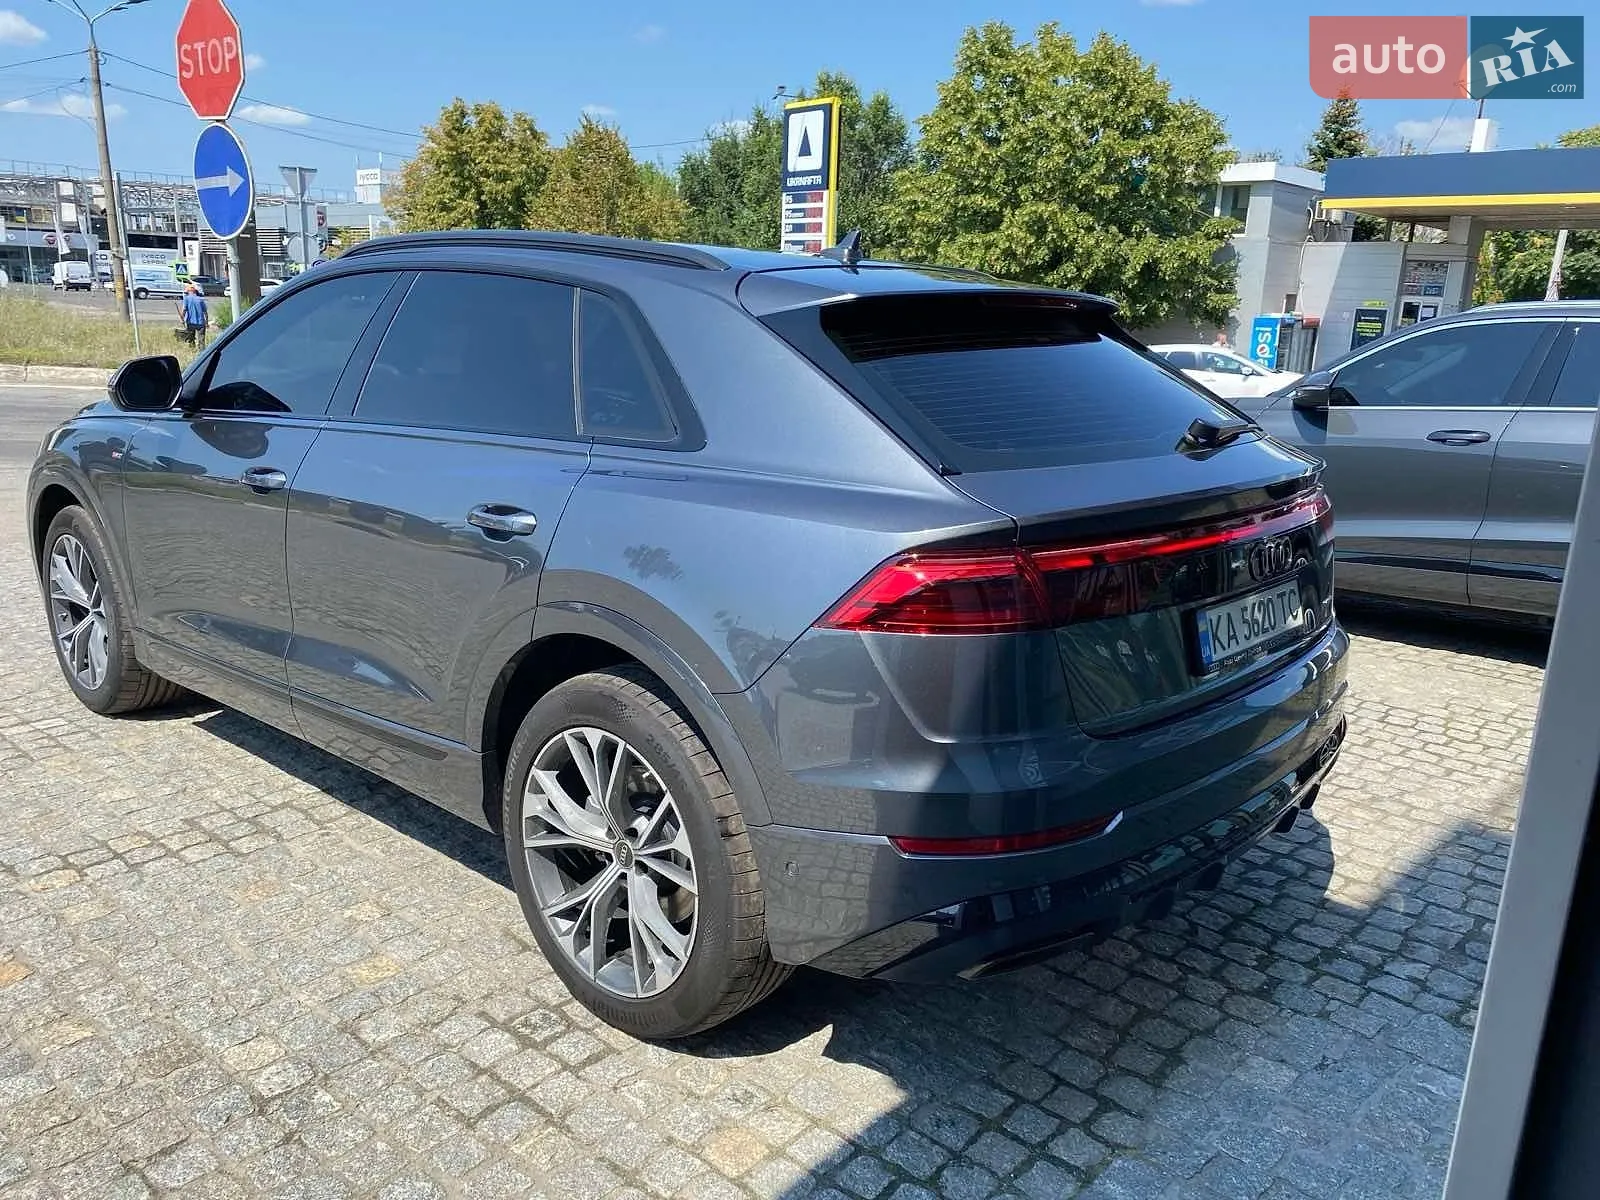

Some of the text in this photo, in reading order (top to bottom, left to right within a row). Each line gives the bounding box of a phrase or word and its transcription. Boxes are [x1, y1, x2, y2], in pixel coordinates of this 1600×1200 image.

[180, 36, 238, 79] STOP
[1255, 326, 1275, 367] epsi
[1210, 612, 1240, 655] KA
[1241, 596, 1277, 641] 5620
[1276, 588, 1298, 625] TC
